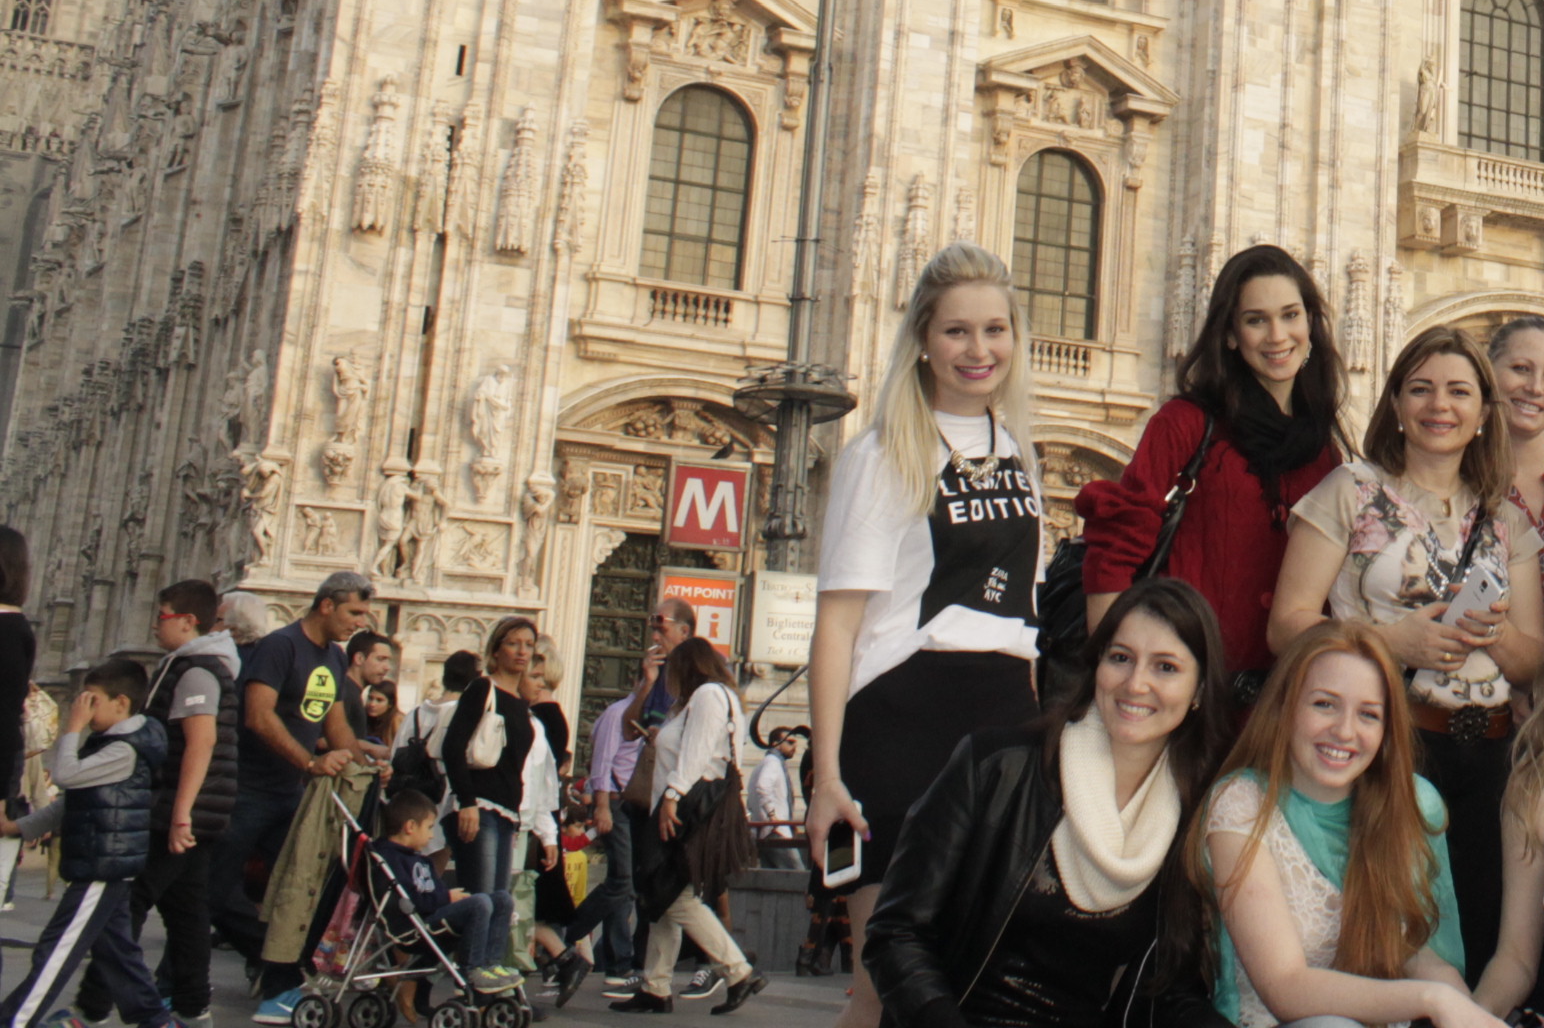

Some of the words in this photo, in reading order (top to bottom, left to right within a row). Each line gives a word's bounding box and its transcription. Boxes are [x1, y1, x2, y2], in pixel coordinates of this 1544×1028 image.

[940, 469, 1031, 496] LIMITE
[673, 477, 738, 533] M
[948, 497, 1039, 524] EDITIO
[664, 584, 693, 598] ATM
[693, 586, 736, 600] POINT
[767, 617, 815, 630] Biglietter
[772, 629, 812, 642] Central
[316, 674, 330, 686] N
